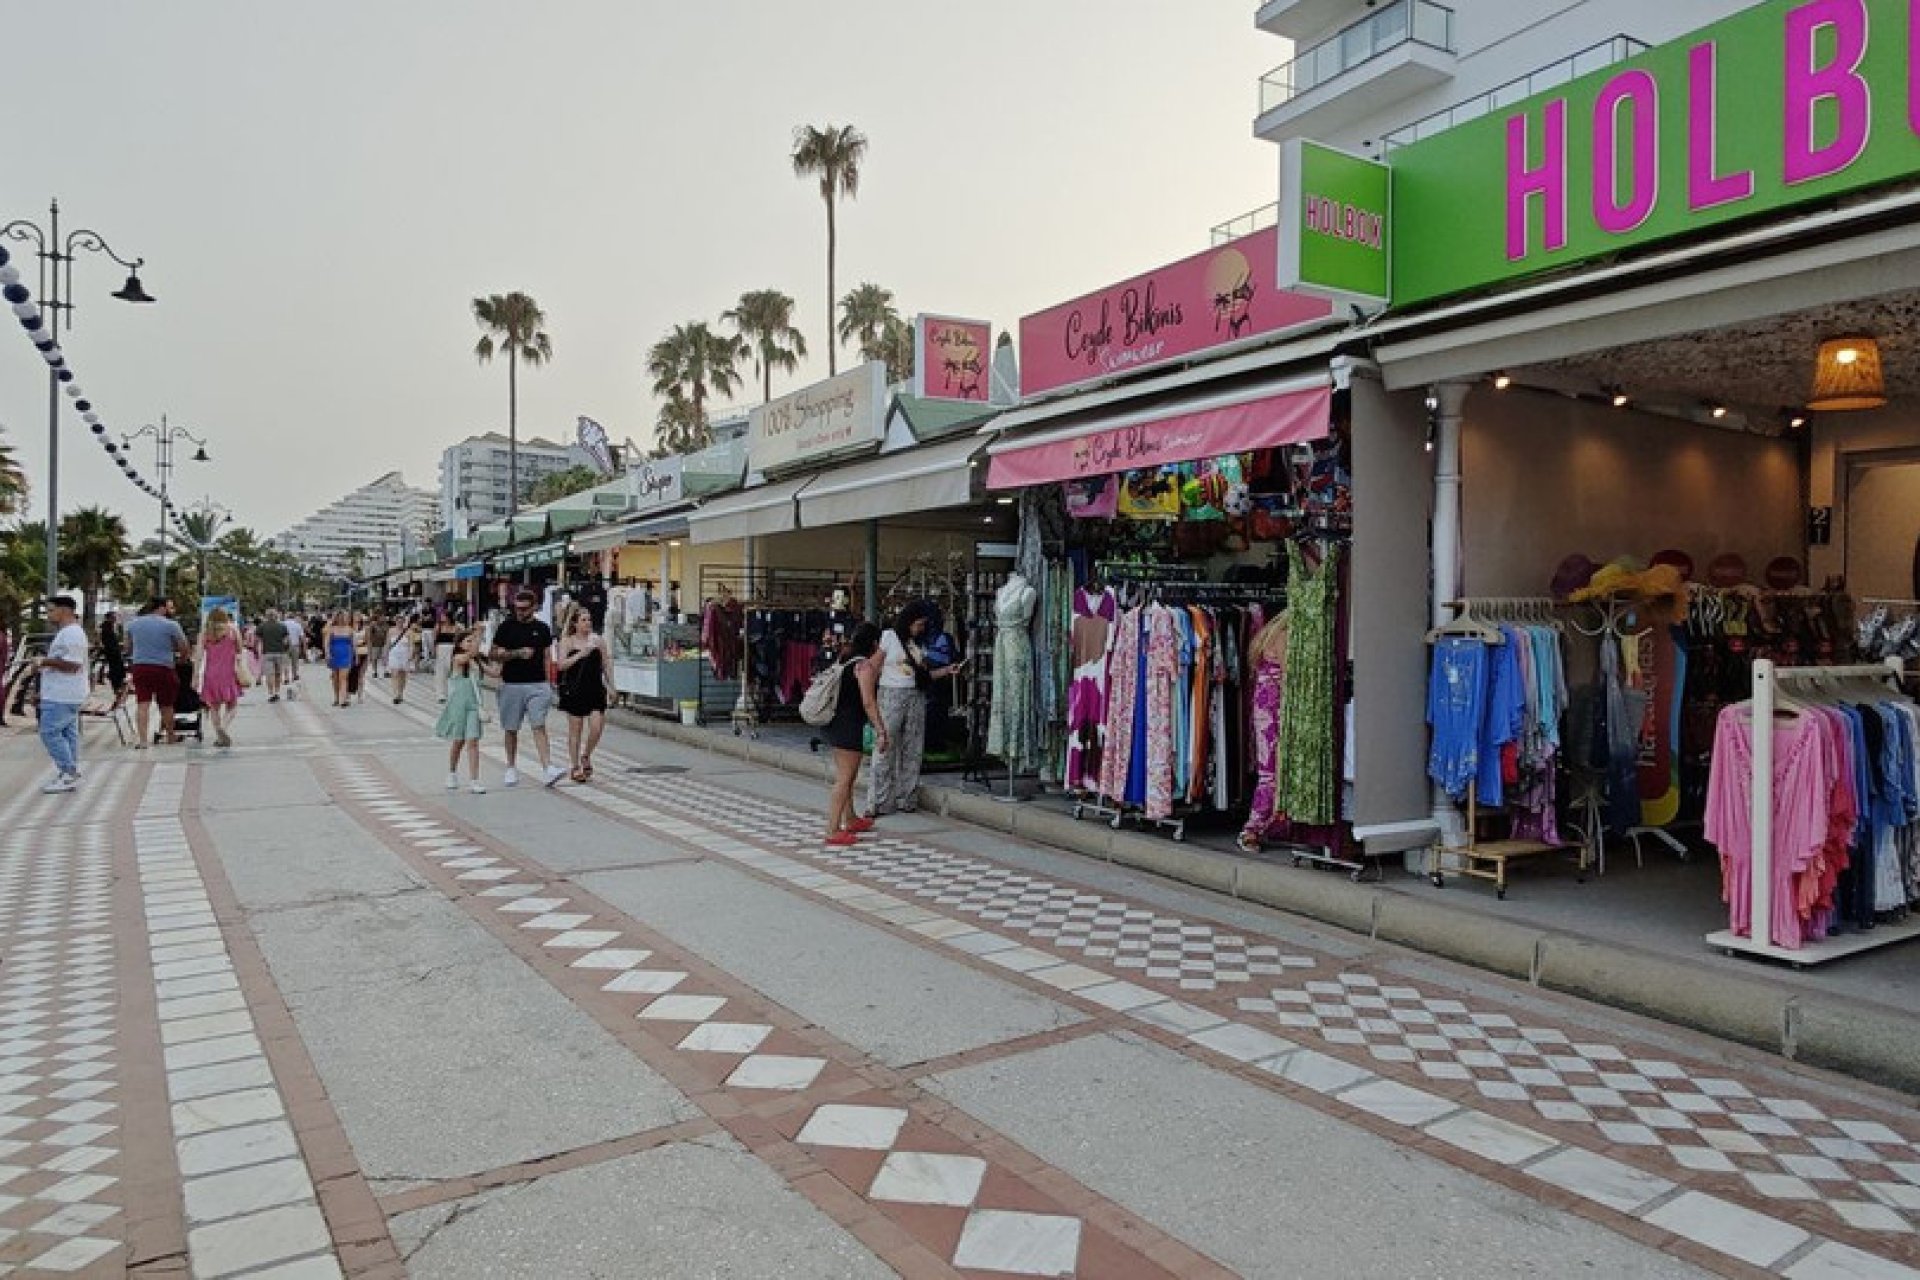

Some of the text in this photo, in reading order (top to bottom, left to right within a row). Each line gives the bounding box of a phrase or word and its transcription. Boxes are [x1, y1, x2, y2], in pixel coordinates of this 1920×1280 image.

[1506, 0, 1920, 261] HOLB
[1306, 192, 1382, 249] HOLBOX
[1120, 280, 1183, 346] Bikinis
